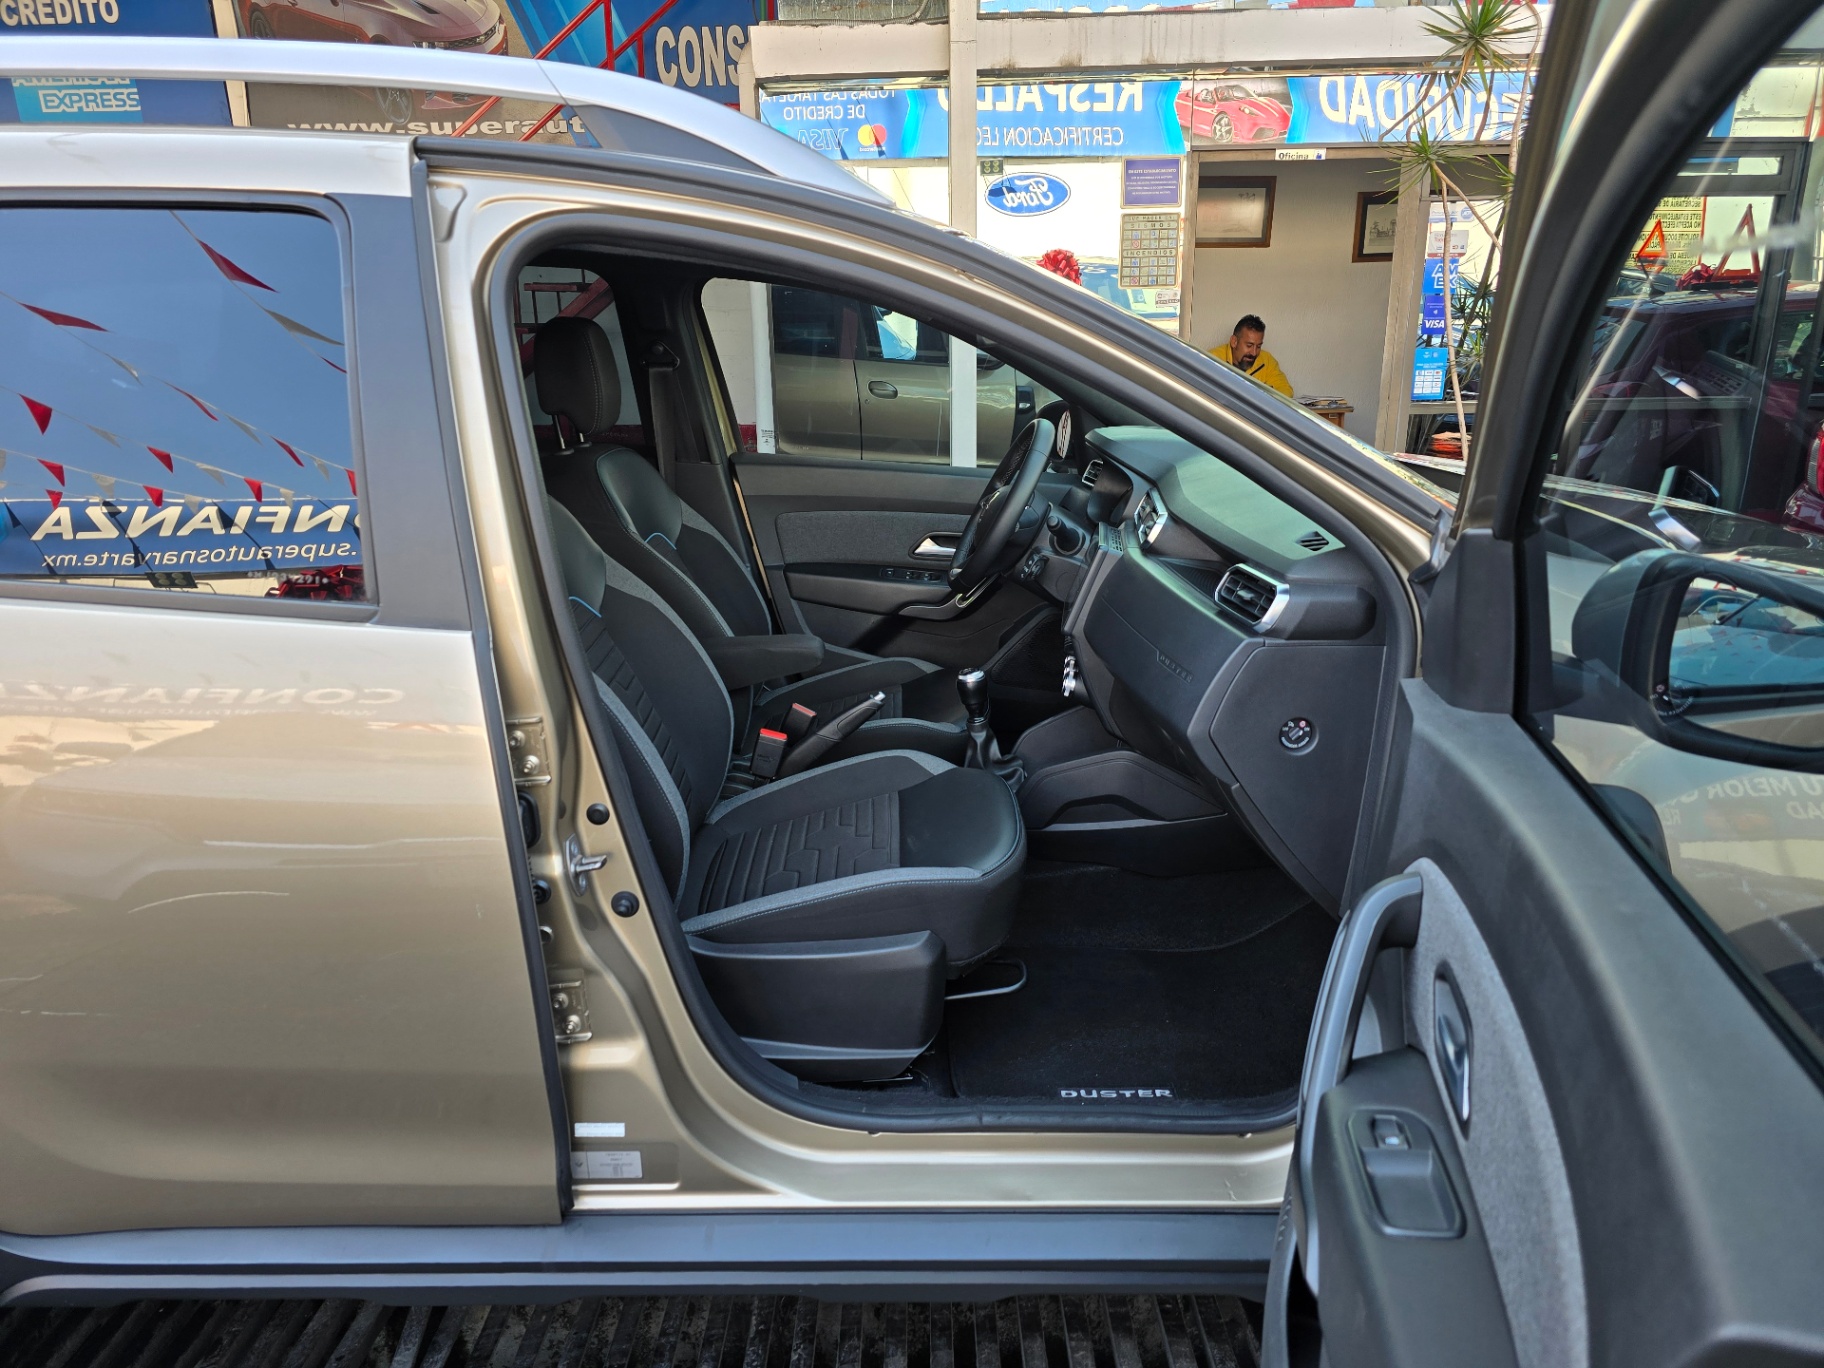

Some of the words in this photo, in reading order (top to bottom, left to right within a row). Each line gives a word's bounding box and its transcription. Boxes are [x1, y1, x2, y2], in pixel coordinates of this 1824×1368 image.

[0, 0, 119, 26] CREDITO
[655, 24, 751, 88] CONS
[38, 88, 141, 112] EXPRESS
[1278, 152, 1309, 161] Oficina
[1424, 319, 1445, 329] VISA
[1060, 1088, 1173, 1098] DUSTER
